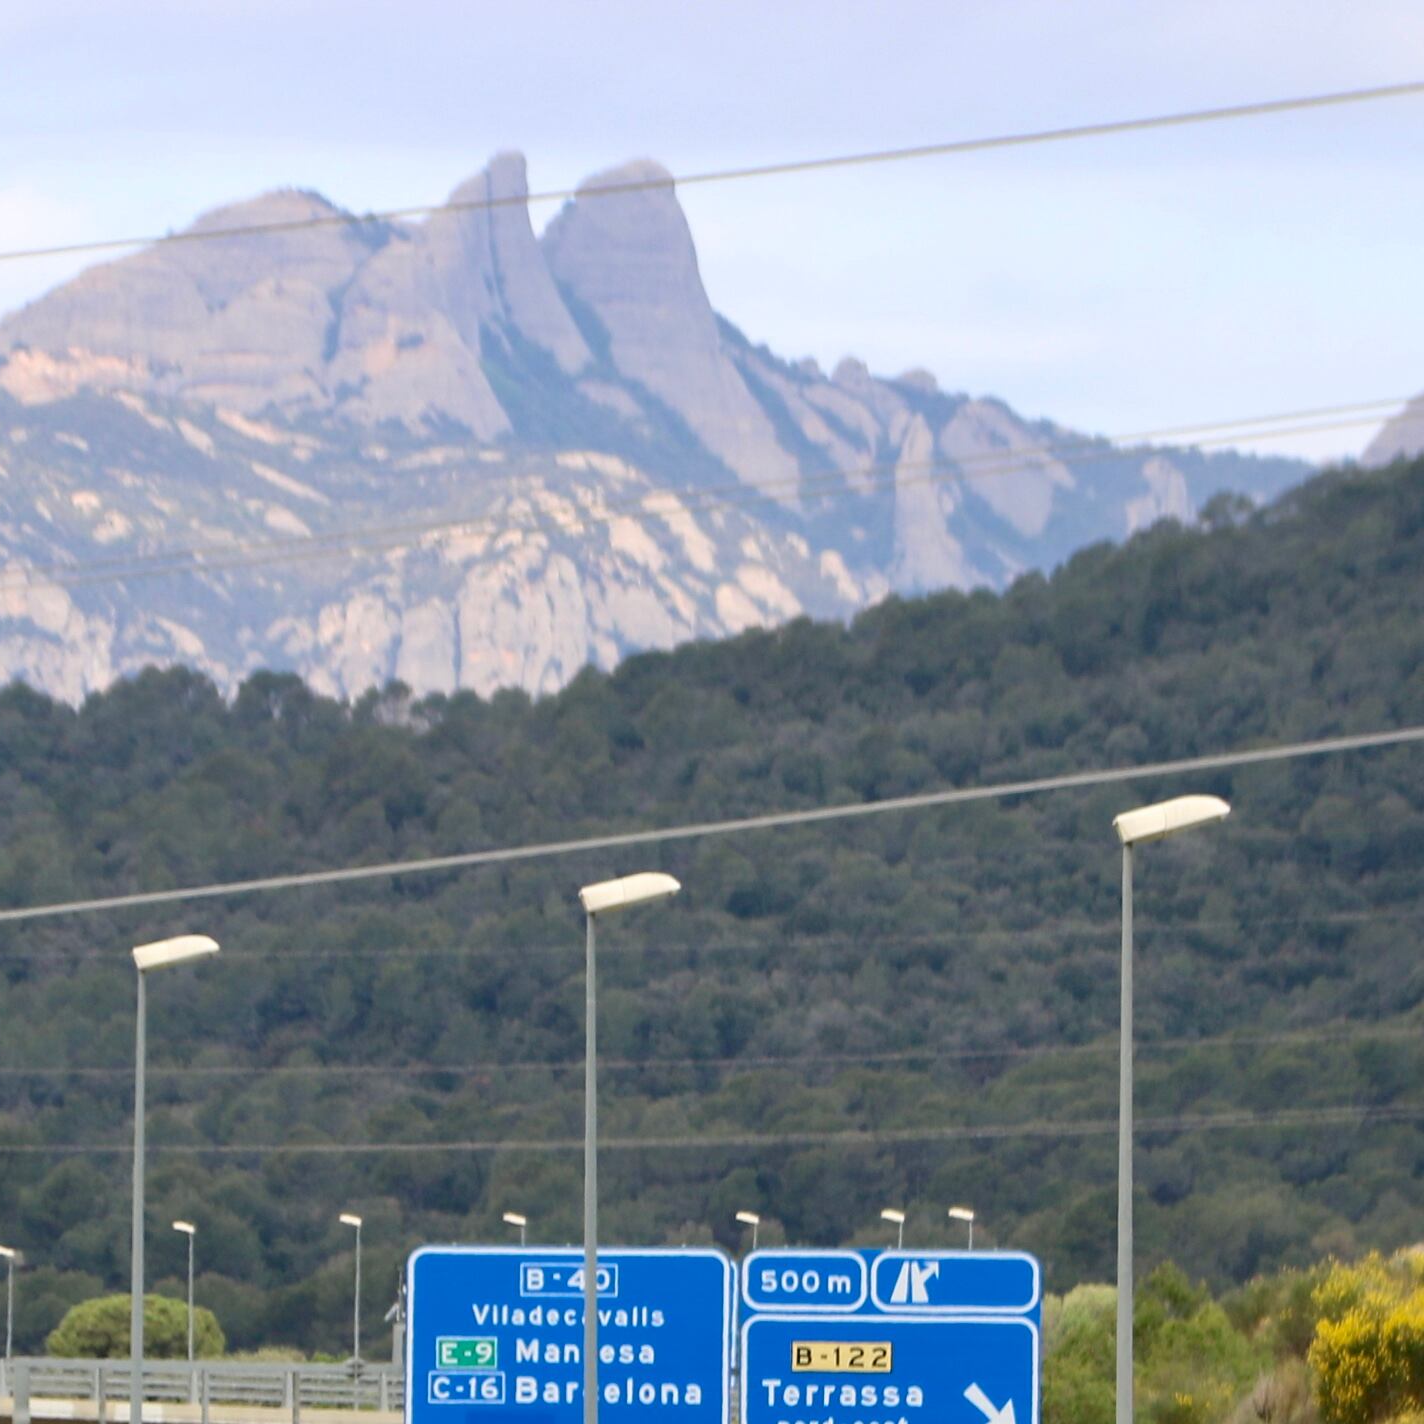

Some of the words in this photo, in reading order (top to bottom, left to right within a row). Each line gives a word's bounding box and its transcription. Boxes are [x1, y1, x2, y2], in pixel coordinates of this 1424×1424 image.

[760, 1269, 820, 1293] 500
[827, 1274, 851, 1294] m
[472, 1303, 665, 1328] Viladecvalls
[441, 1342, 493, 1364] E-9
[515, 1338, 655, 1364] Manesa
[795, 1346, 888, 1368] B-122
[432, 1376, 499, 1400] C-16
[515, 1376, 702, 1405] Barelona
[761, 1378, 924, 1407] Terrassa
